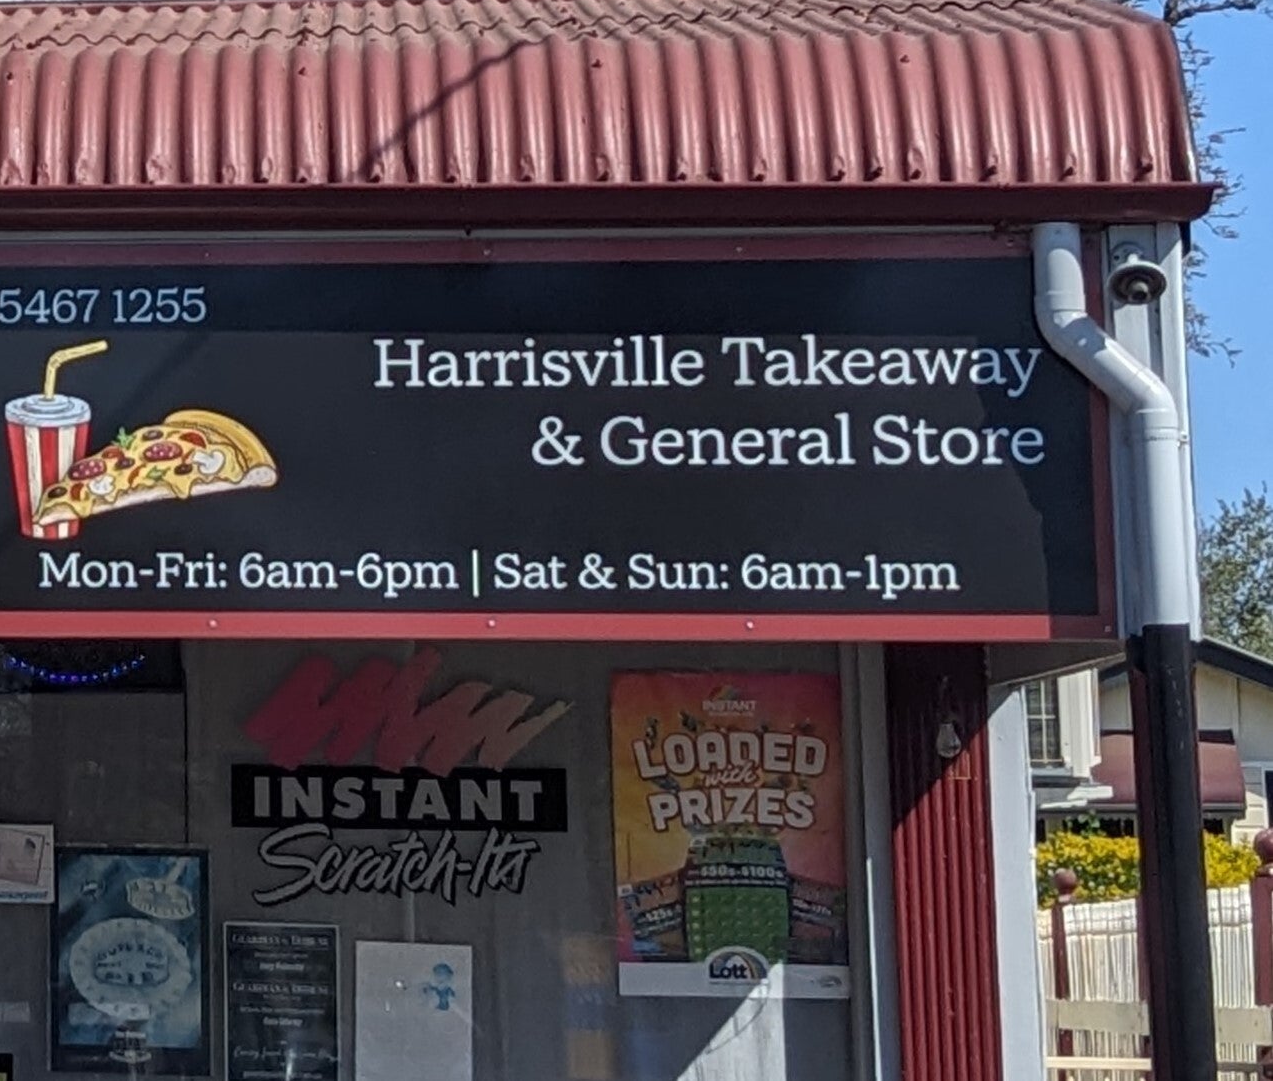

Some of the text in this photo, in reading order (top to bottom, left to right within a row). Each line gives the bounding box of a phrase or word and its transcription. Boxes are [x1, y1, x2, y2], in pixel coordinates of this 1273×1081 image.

[113, 287, 206, 322] 1255
[374, 334, 1040, 396] Harrisville Takeaway
[532, 413, 1043, 465] & General Store
[40, 553, 226, 587] Mon-Fri:
[240, 553, 458, 597] 6am-6pm
[495, 553, 567, 589] Sat
[579, 554, 617, 589] &
[628, 554, 728, 589] Sun:
[742, 554, 959, 599] 6am-1pm
[632, 730, 828, 779] LOADED
[254, 776, 543, 821] INSTANT
[649, 787, 816, 831] PRIZES
[254, 822, 541, 906] Scratch-Its
